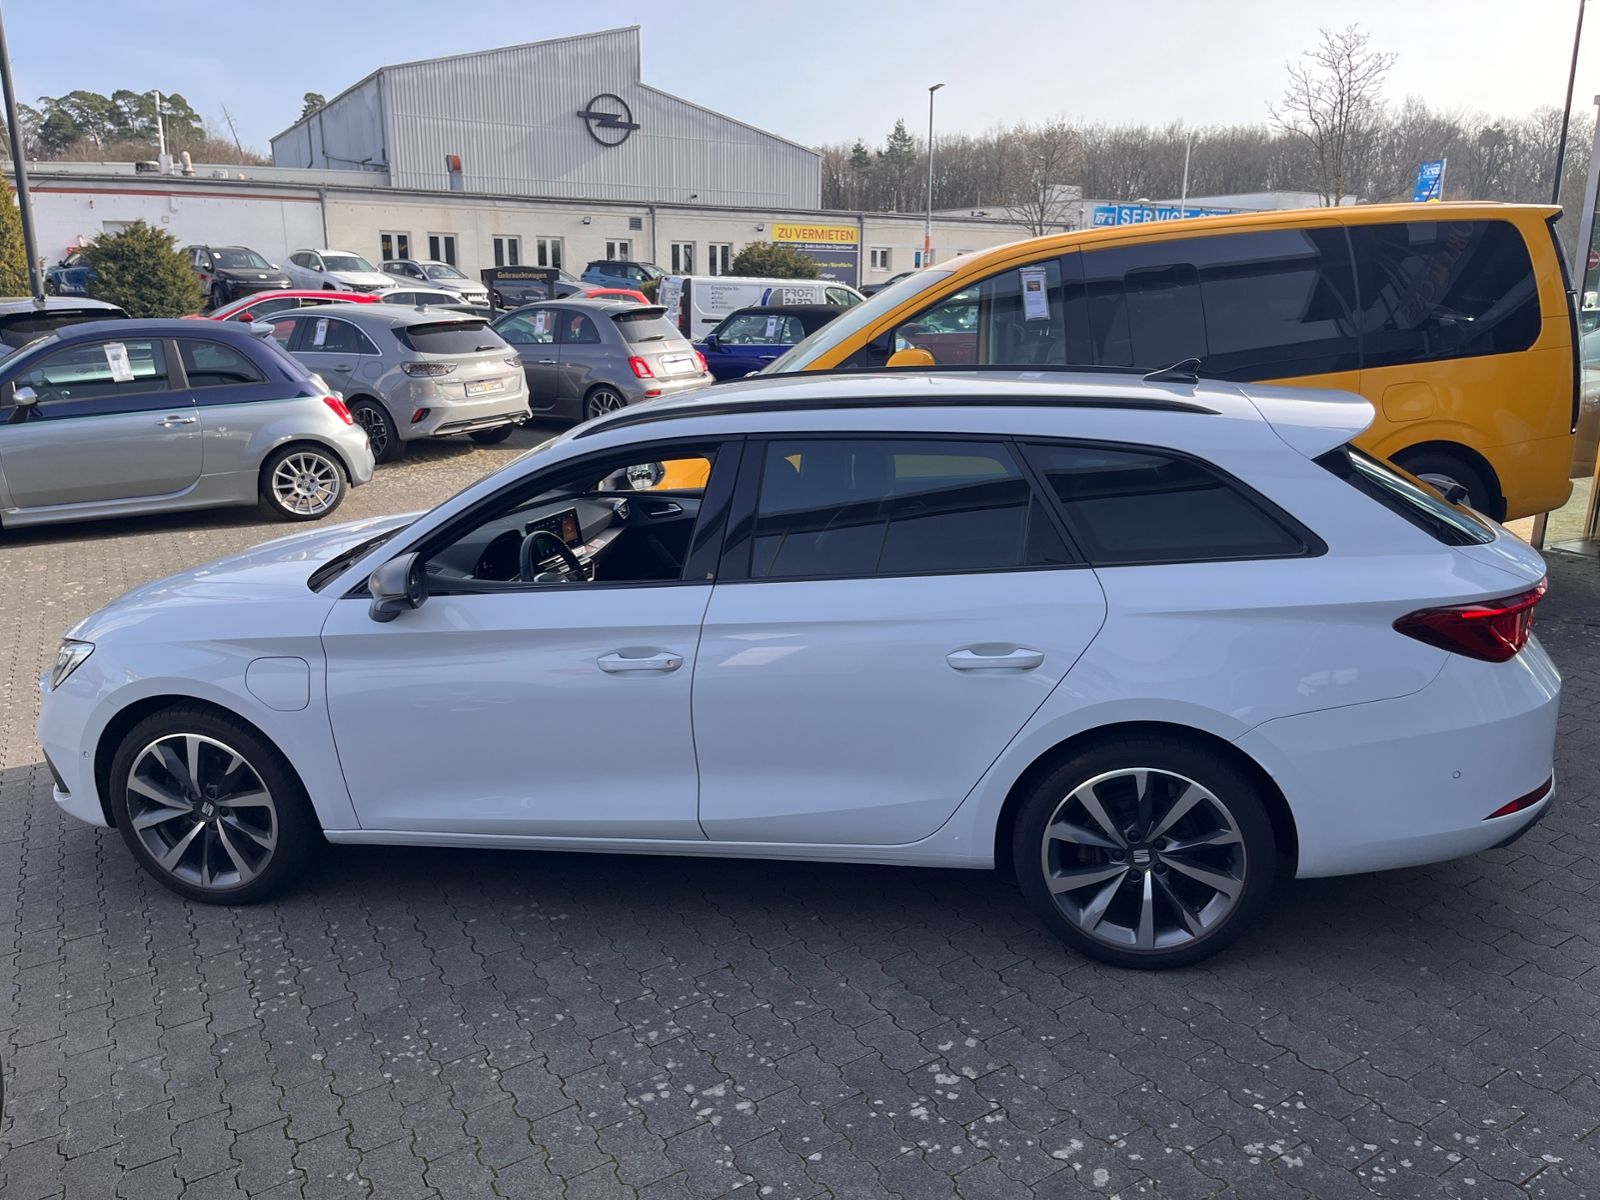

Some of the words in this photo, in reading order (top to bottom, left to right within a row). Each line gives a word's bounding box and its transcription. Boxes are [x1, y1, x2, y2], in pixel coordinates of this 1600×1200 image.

[778, 227, 792, 239] ZU
[795, 228, 854, 241] VERMIETEN
[497, 271, 548, 280] Gebrauchtwagen
[785, 288, 814, 298] PROFI
